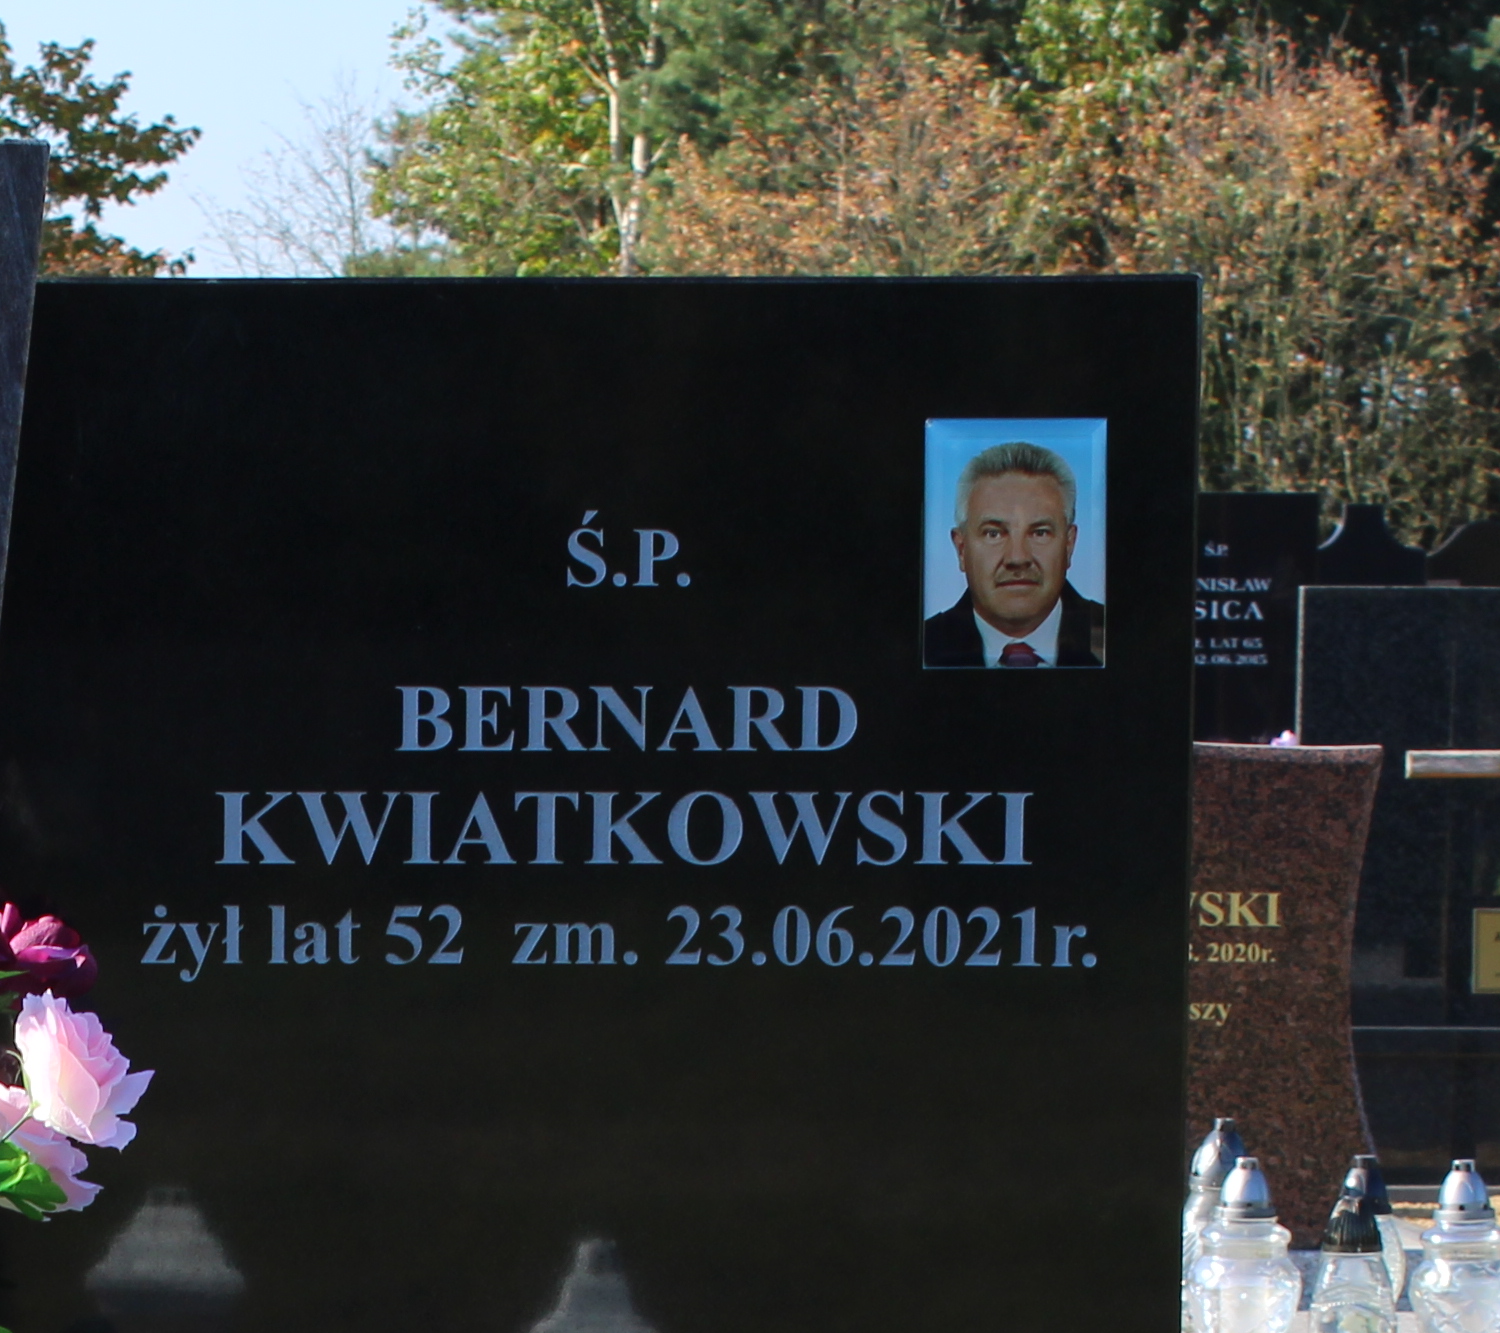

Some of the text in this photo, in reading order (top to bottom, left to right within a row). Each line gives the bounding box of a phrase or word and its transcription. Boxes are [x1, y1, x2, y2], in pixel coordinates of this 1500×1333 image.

[567, 508, 691, 588] Ś.P.
[395, 685, 858, 752] BERNARD
[214, 790, 1034, 866] KWIATKOWSKI
[141, 904, 1098, 984] żył lat 52 zm. 23.06.2021r.
[1206, 942, 1278, 963] 2020r.
